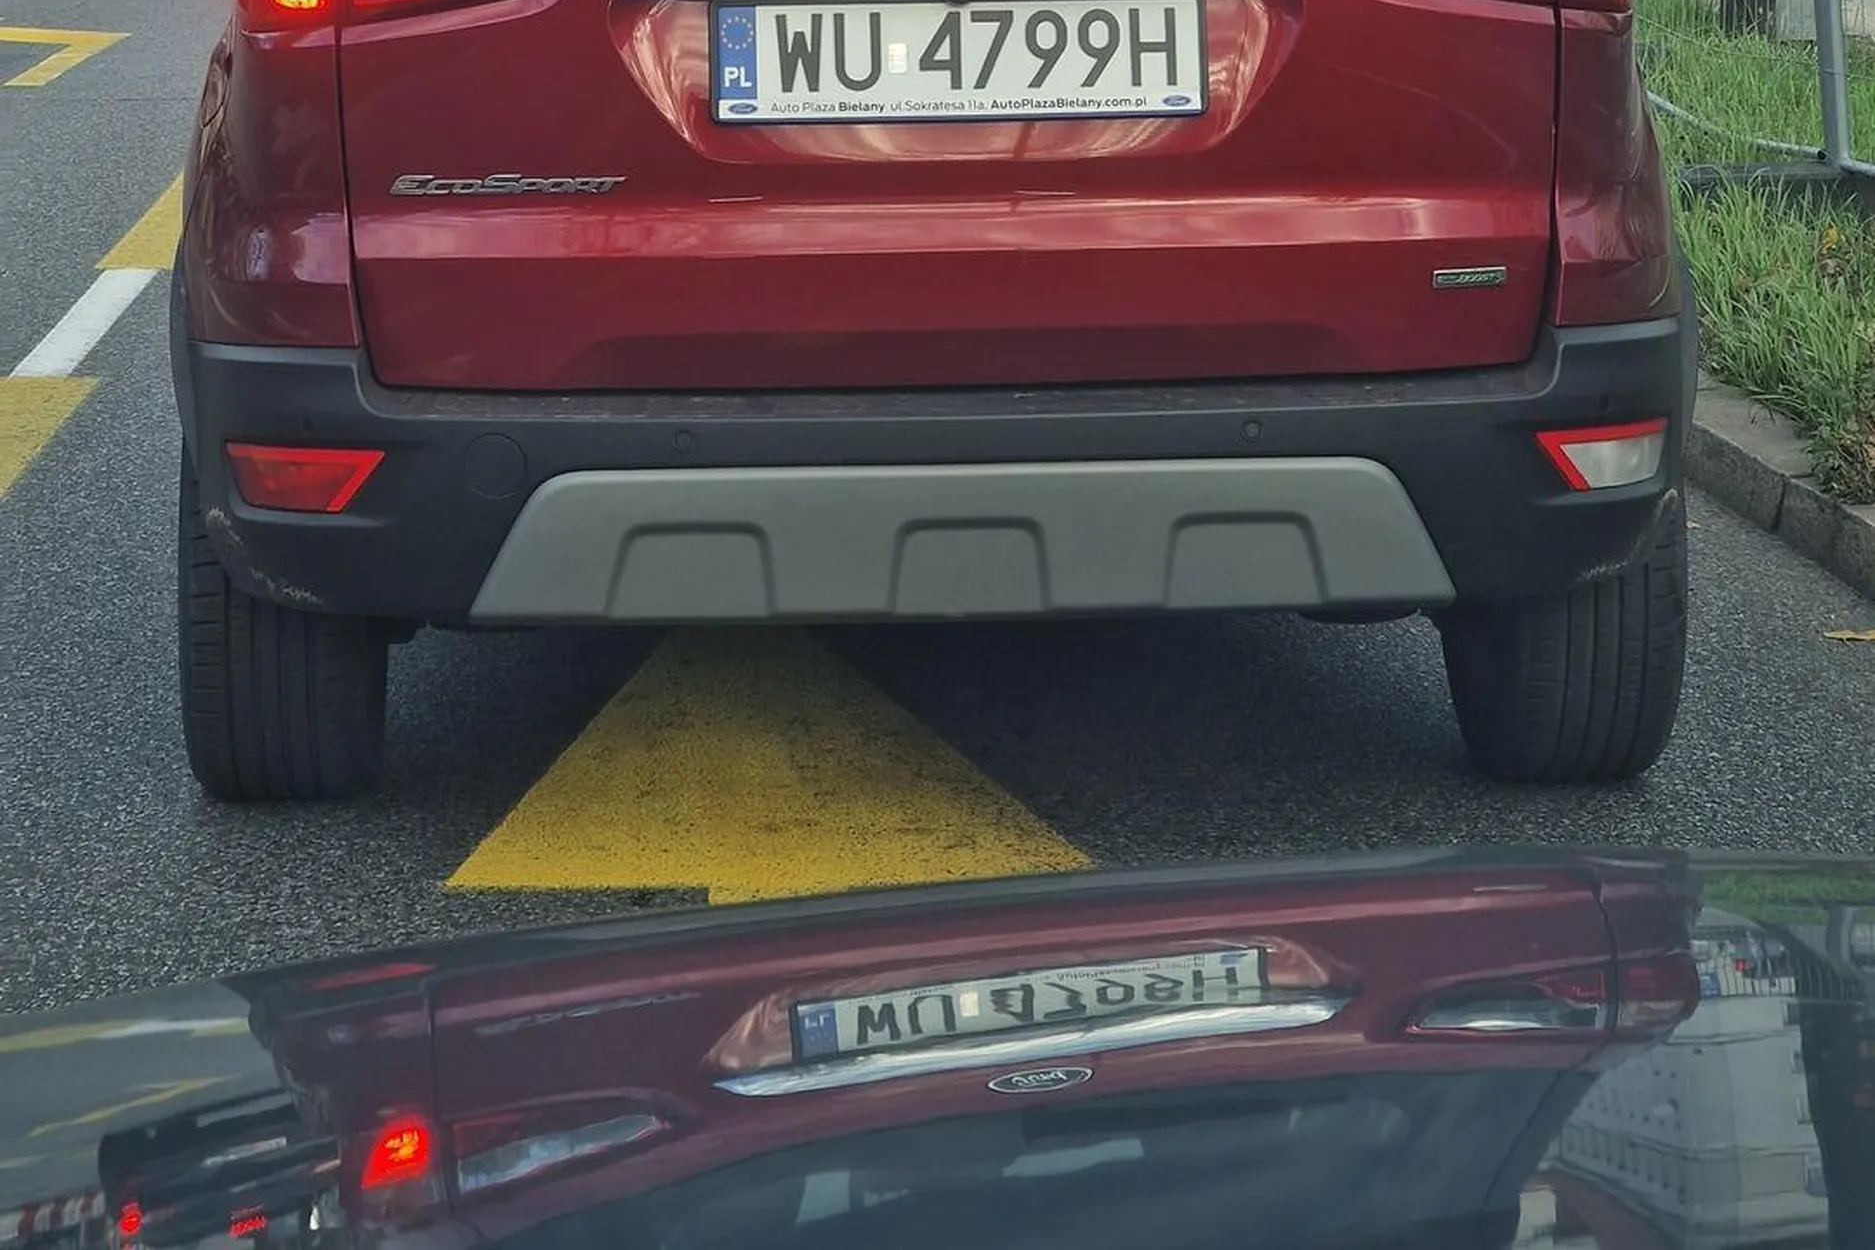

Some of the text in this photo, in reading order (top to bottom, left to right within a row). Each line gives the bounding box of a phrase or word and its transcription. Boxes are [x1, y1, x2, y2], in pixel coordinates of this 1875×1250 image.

[775, 8, 1178, 92] WU 4799H
[724, 67, 752, 87] PL
[771, 102, 800, 113] Auto
[803, 102, 836, 112] Plaza
[839, 101, 885, 113] Bielany
[905, 100, 965, 111] Sokratesa
[991, 97, 1147, 109] AutoPlazaBielany.com.pl
